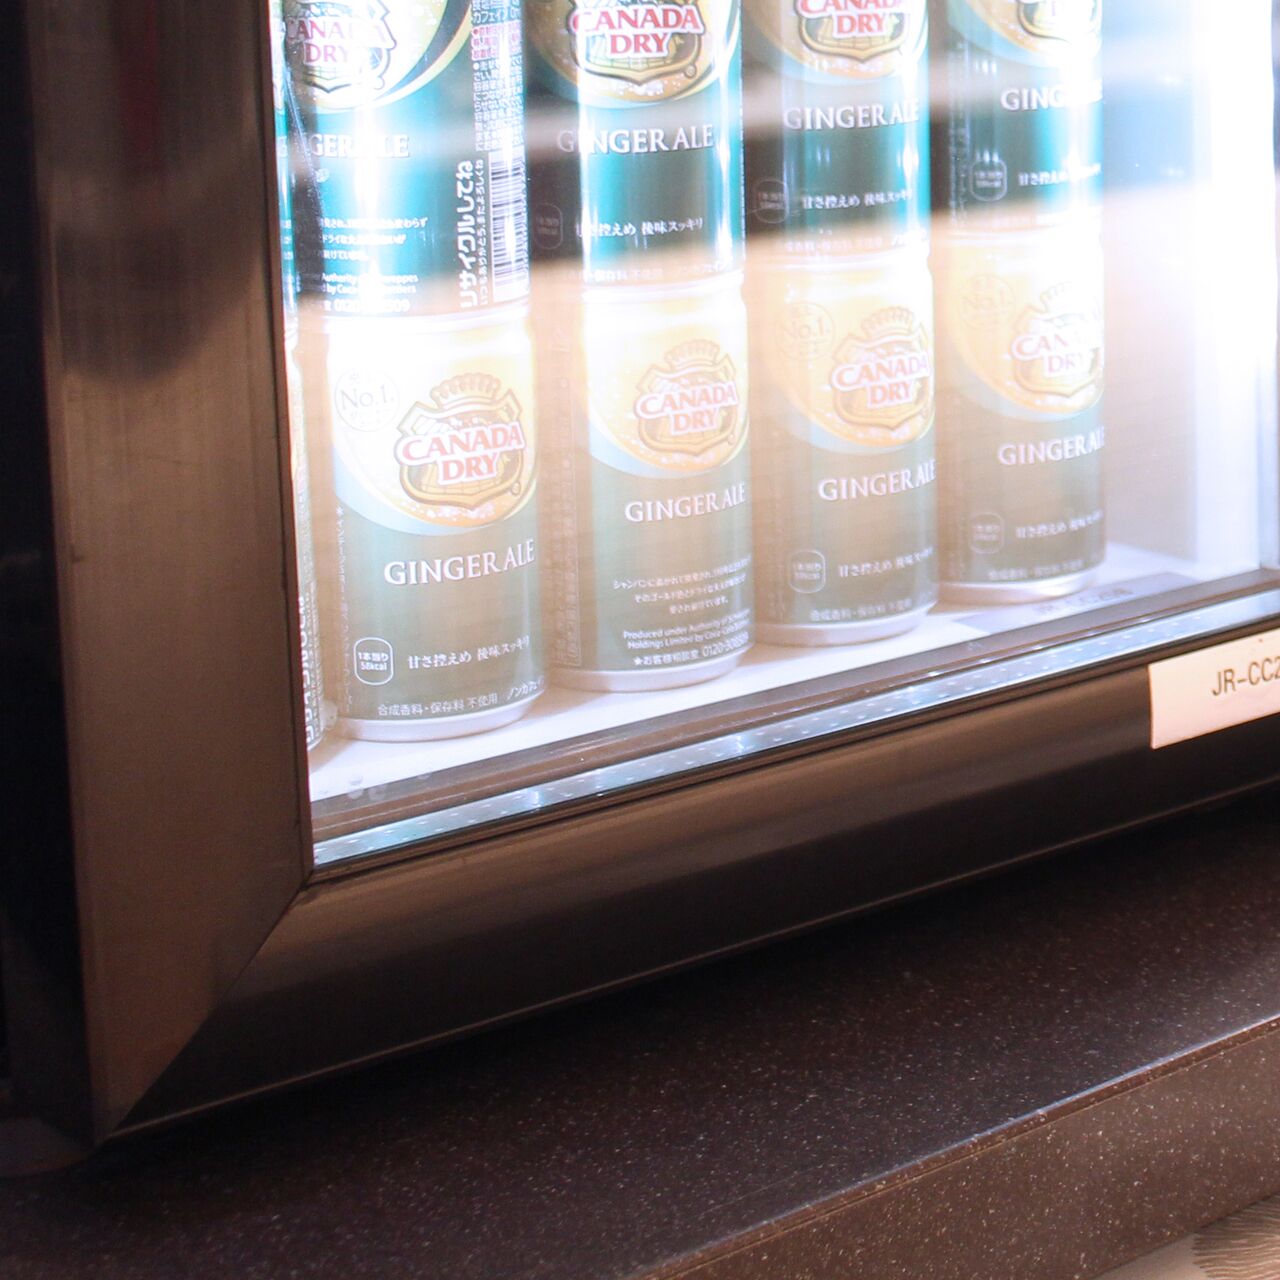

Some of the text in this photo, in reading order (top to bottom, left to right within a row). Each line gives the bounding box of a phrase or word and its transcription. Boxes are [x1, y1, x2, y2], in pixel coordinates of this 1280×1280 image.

[572, 7, 701, 34] CANADA
[836, 14, 887, 37] DRY
[609, 33, 668, 55] DRY
[783, 97, 920, 131] GINGER ALE
[556, 124, 714, 154] GNGER ALE
[456, 160, 478, 308] リサイクルしてね
[834, 352, 930, 389] CANADA
[638, 380, 738, 421] CANADA
[869, 381, 914, 406] DRY
[673, 407, 719, 433] DRY
[402, 423, 525, 462] CANADA
[997, 434, 1088, 467] GINGER
[441, 454, 499, 483] DRY
[818, 458, 937, 503] GINGER ALE
[624, 480, 747, 523] GINGER ALE
[383, 539, 536, 586] GINGER ALE
[406, 650, 473, 671] 甘さ控えめ
